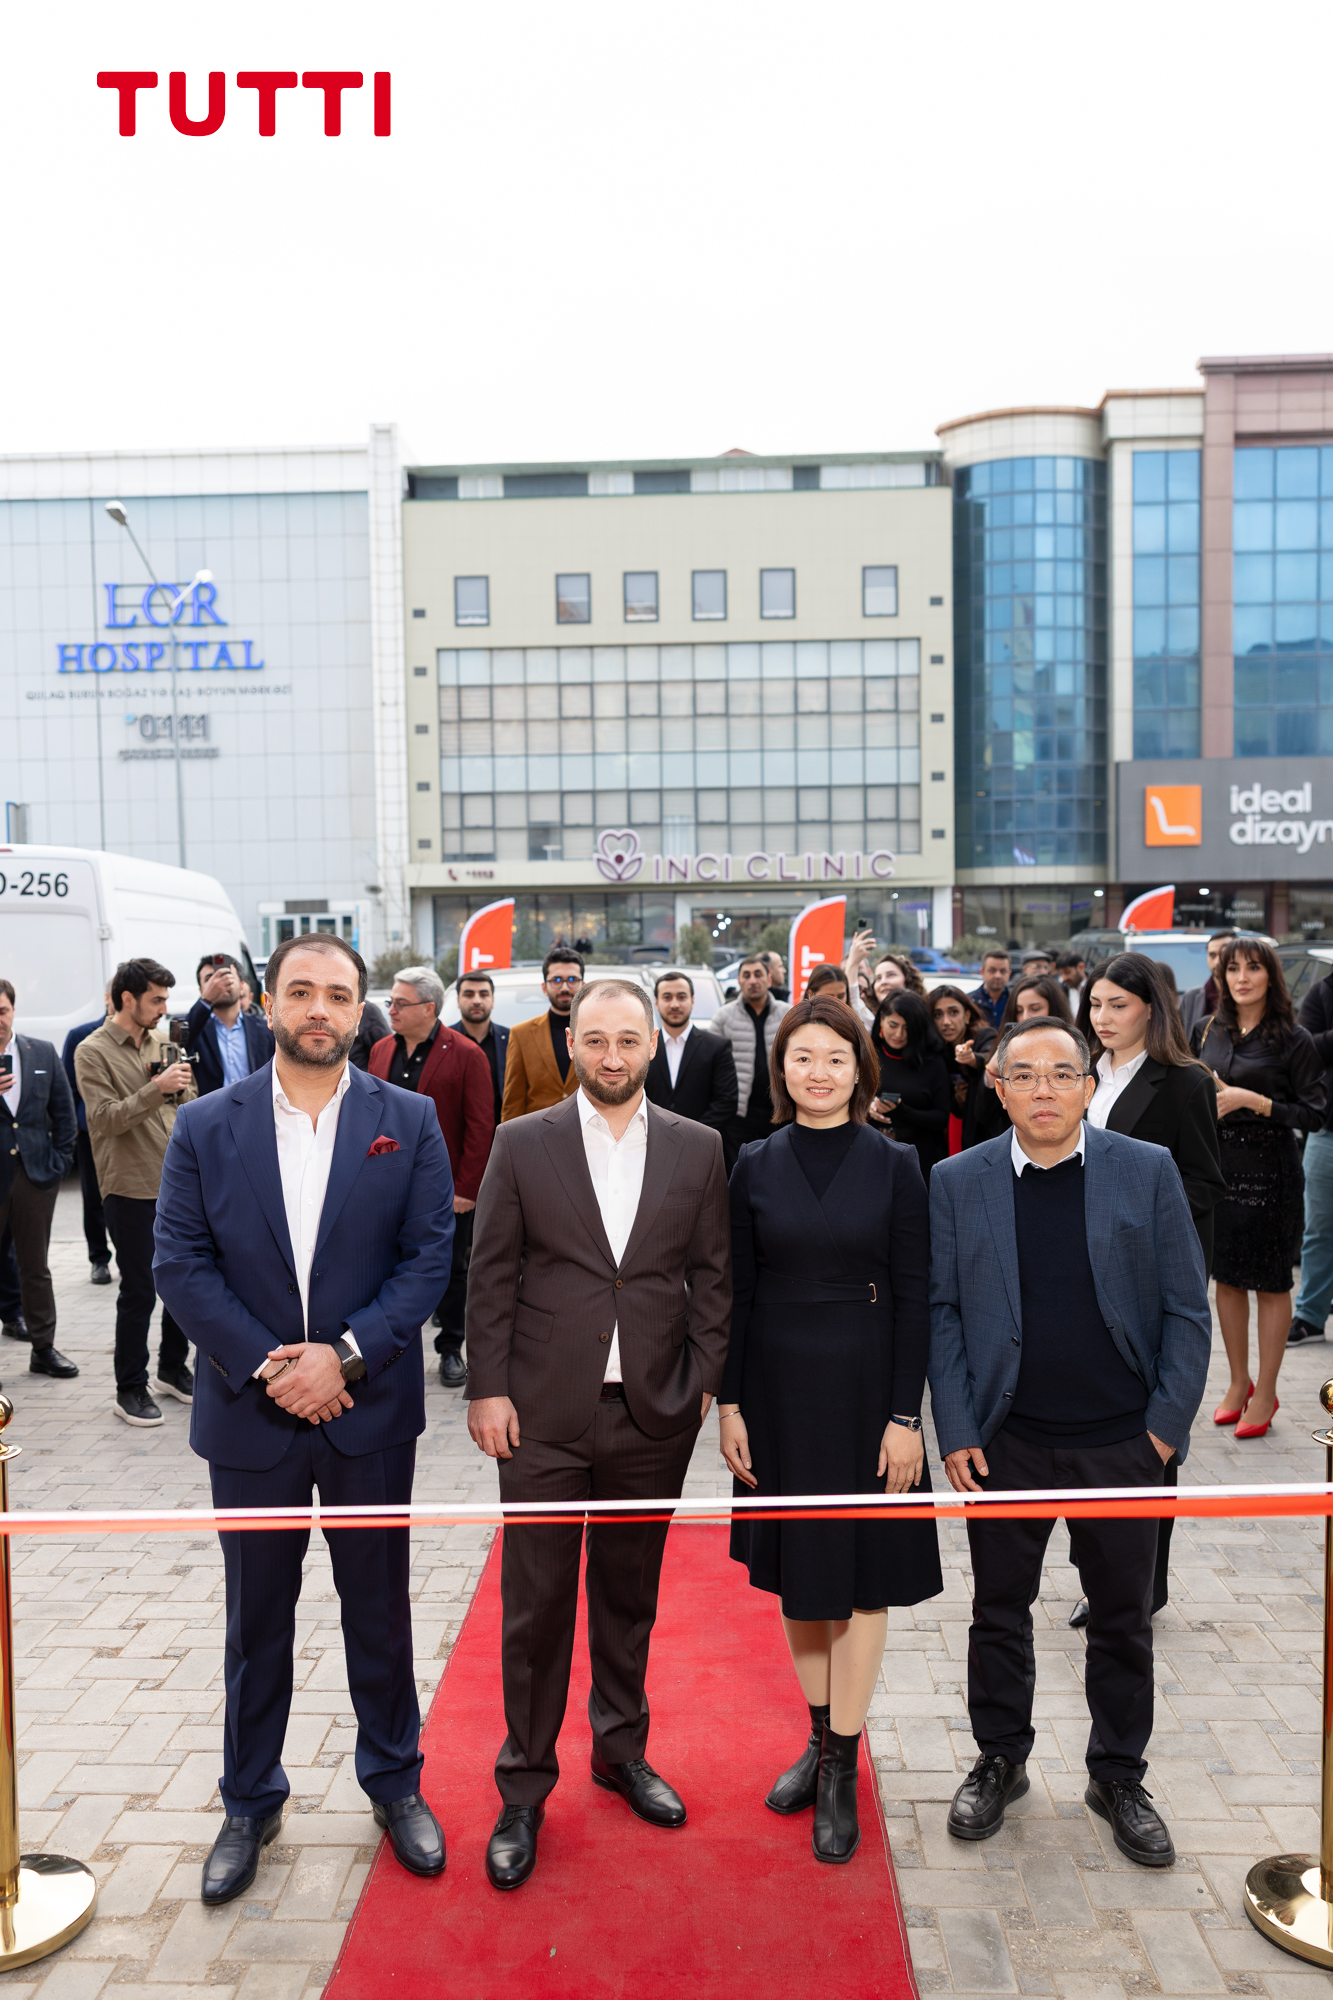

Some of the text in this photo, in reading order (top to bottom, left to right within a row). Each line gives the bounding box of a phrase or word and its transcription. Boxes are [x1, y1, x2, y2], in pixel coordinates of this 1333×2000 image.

[104, 581, 229, 628] LOR
[1230, 781, 1312, 814] ideal
[1229, 814, 1333, 854] dizayn
[653, 850, 897, 883] INCI CLINIC
